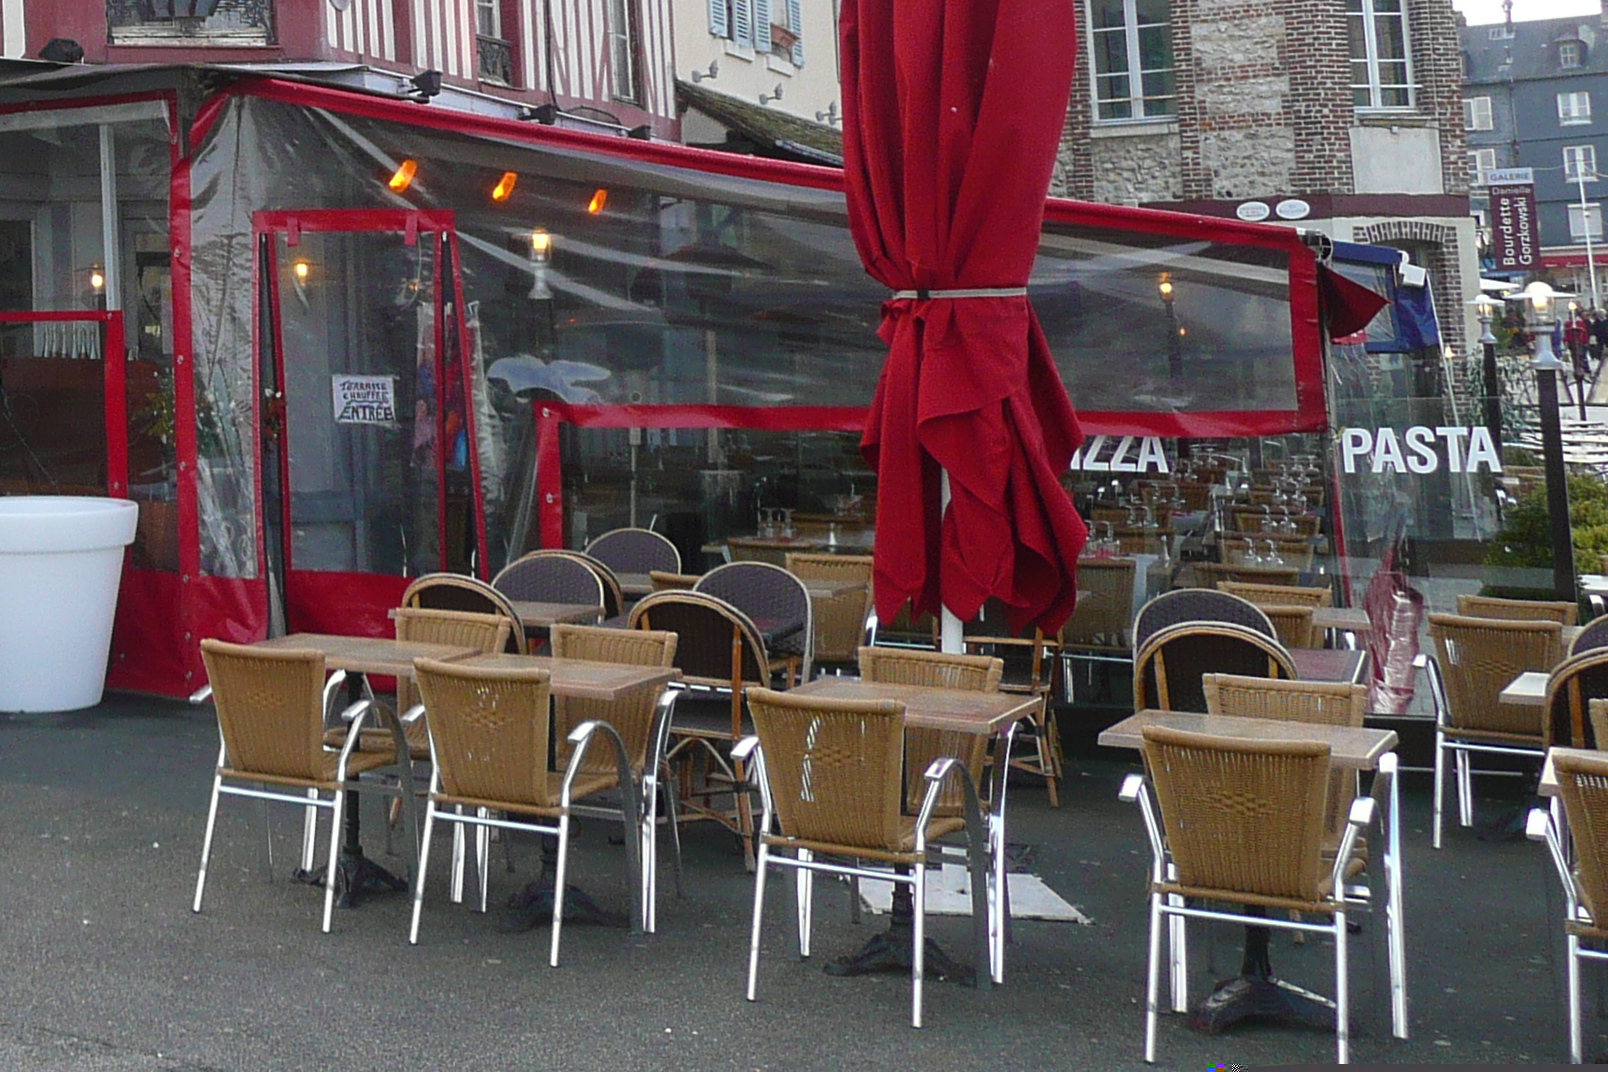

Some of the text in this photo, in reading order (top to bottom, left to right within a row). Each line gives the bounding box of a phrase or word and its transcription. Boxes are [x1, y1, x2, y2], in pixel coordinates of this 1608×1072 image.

[1489, 172, 1529, 181] GALERIE
[1492, 186, 1531, 195] Danielle
[1499, 197, 1516, 266] Bourdette
[1513, 196, 1532, 265] Gorzkowski
[1070, 426, 1502, 474] ZZA PASTA
